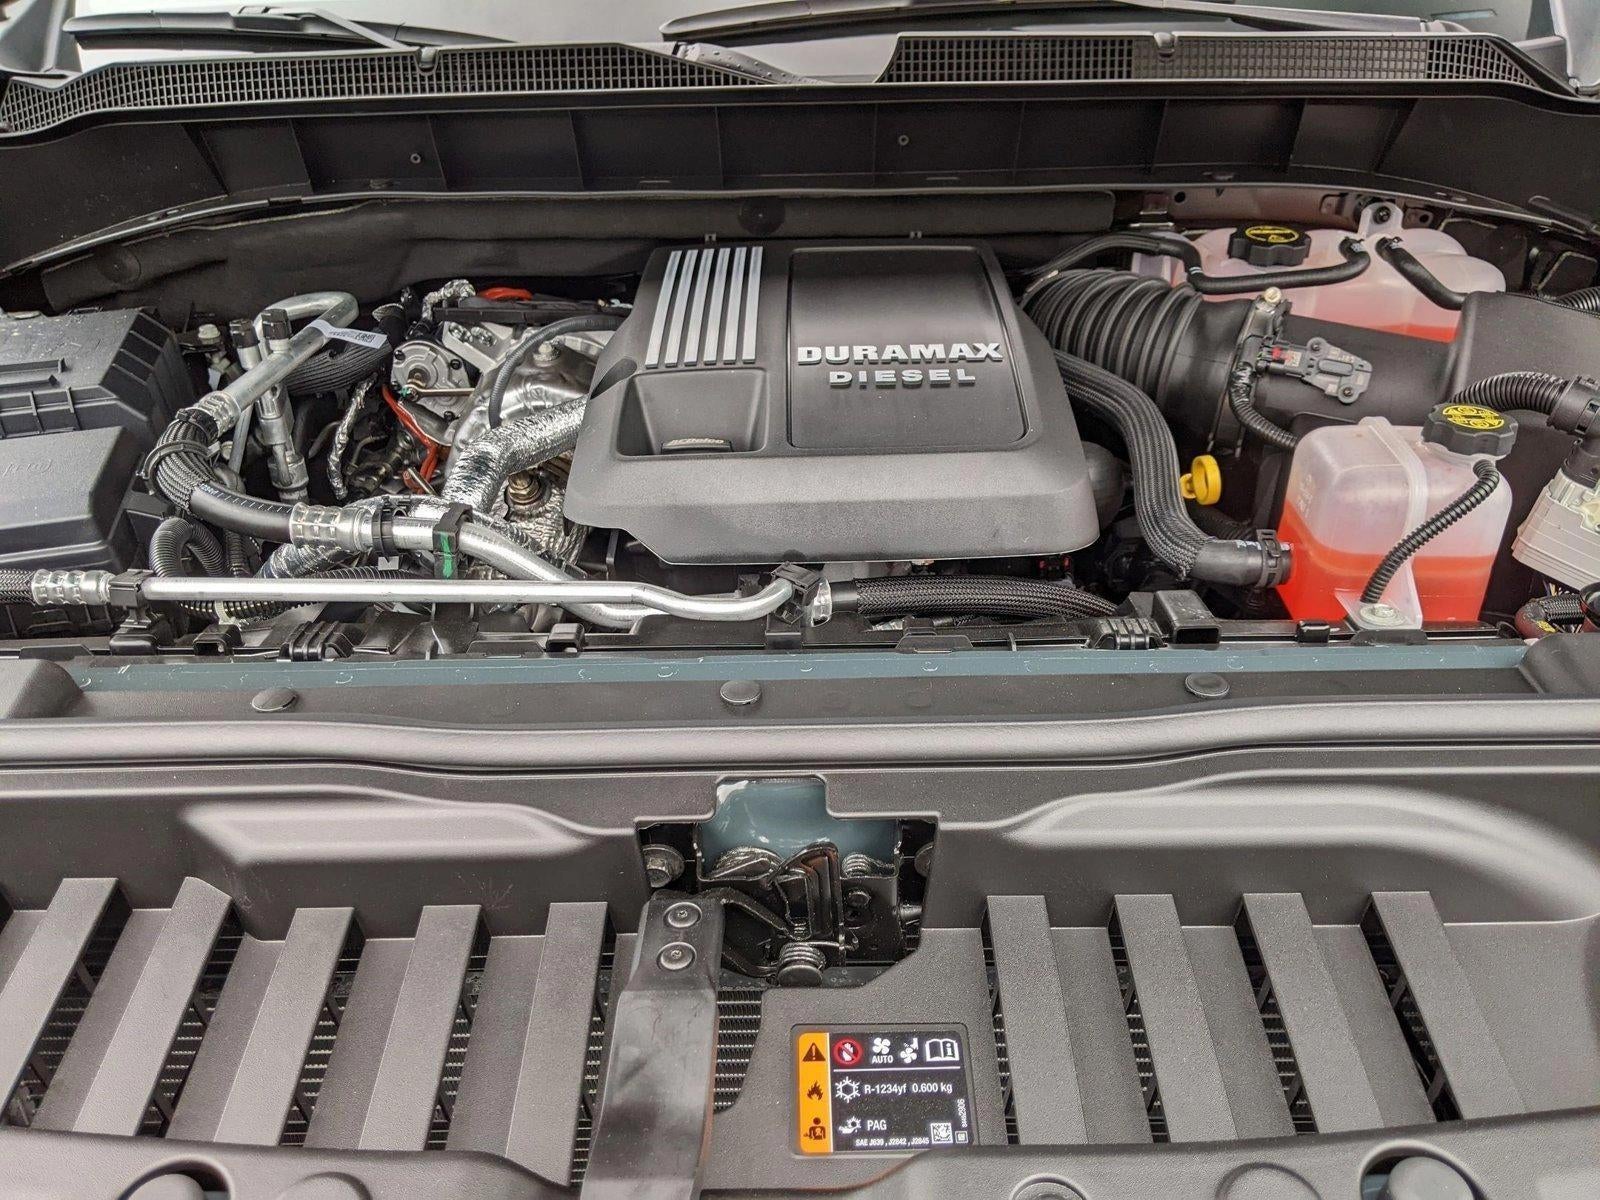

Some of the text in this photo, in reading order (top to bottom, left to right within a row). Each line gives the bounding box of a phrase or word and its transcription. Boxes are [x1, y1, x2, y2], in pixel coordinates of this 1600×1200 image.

[798, 342, 1003, 365] DURAMAX
[829, 368, 976, 388] DIESEL
[871, 1055, 894, 1064] AUTO
[864, 1082, 953, 1096] R-1234yf 0.600 kg
[867, 1119, 887, 1131] PAG
[855, 1138, 868, 1146] SAE
